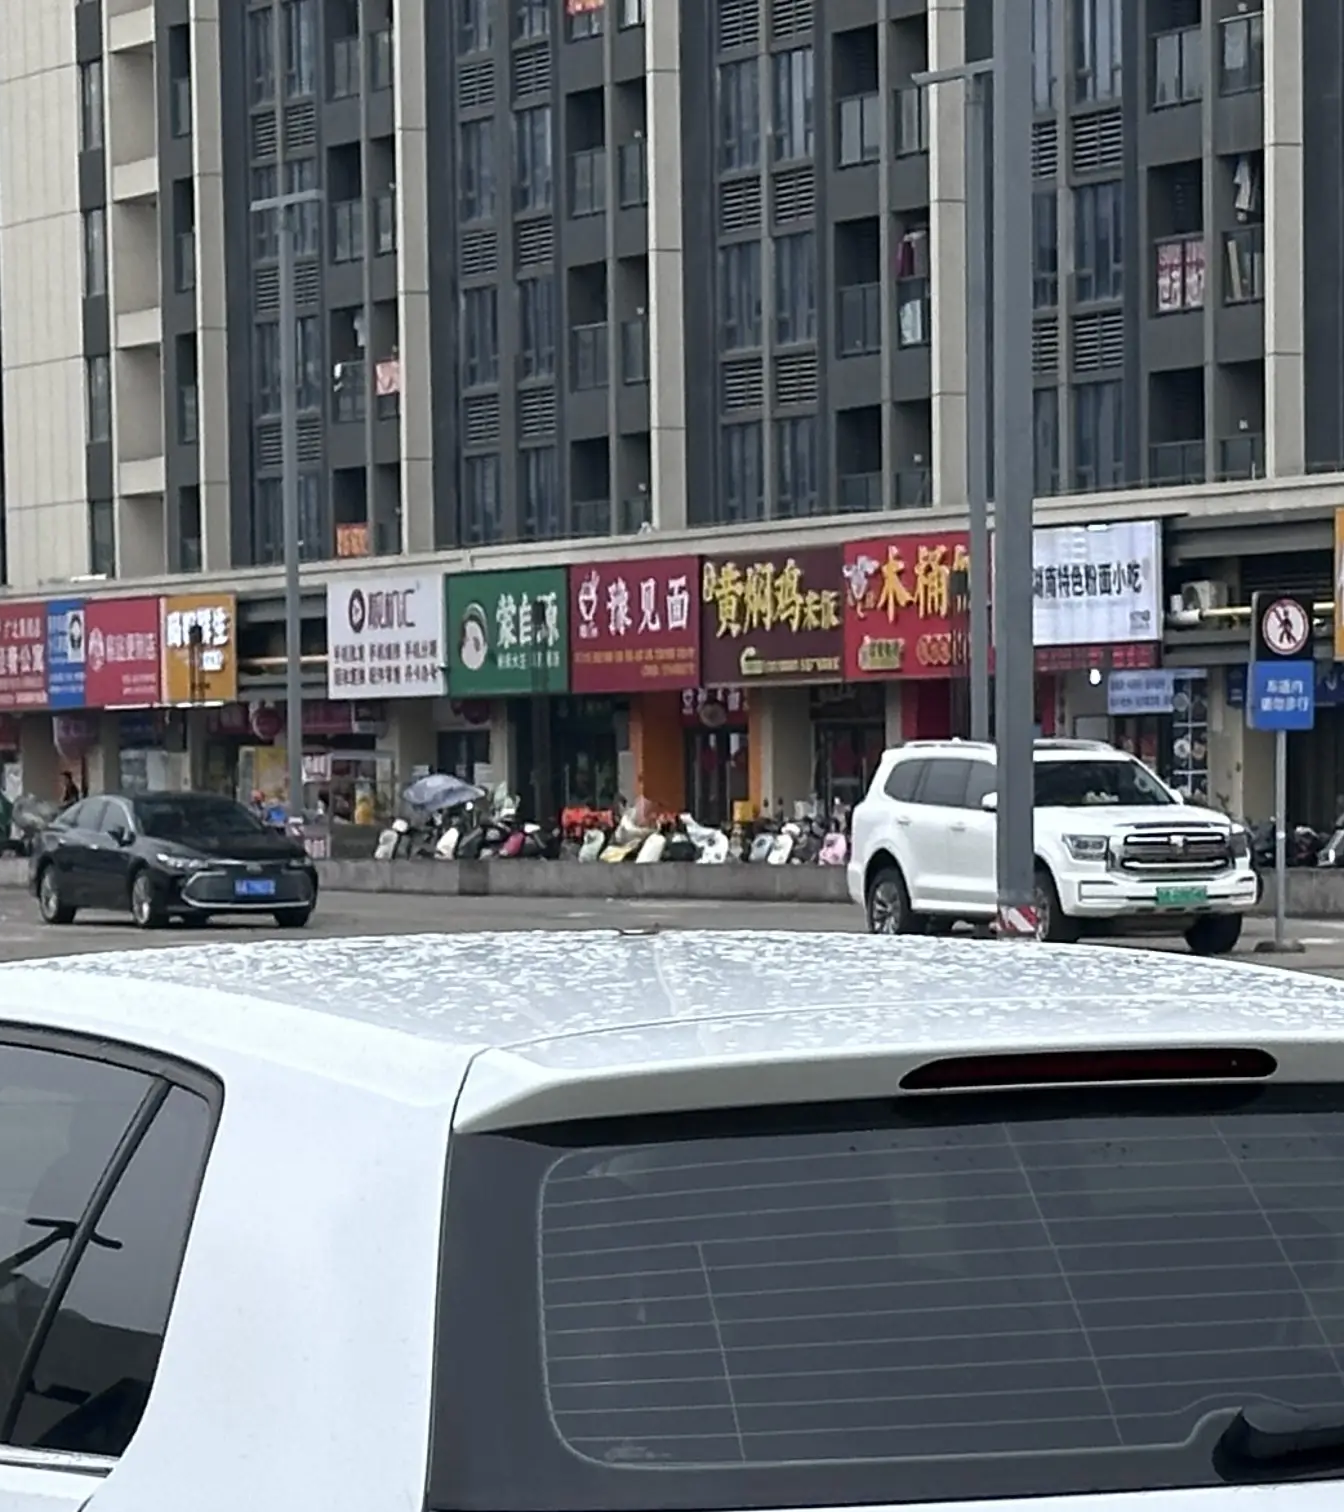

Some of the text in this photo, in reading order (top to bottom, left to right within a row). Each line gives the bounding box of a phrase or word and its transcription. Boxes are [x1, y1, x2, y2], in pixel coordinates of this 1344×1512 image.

[606, 575, 690, 636] 豫见面
[715, 558, 840, 638] 黄焖鸡米饭
